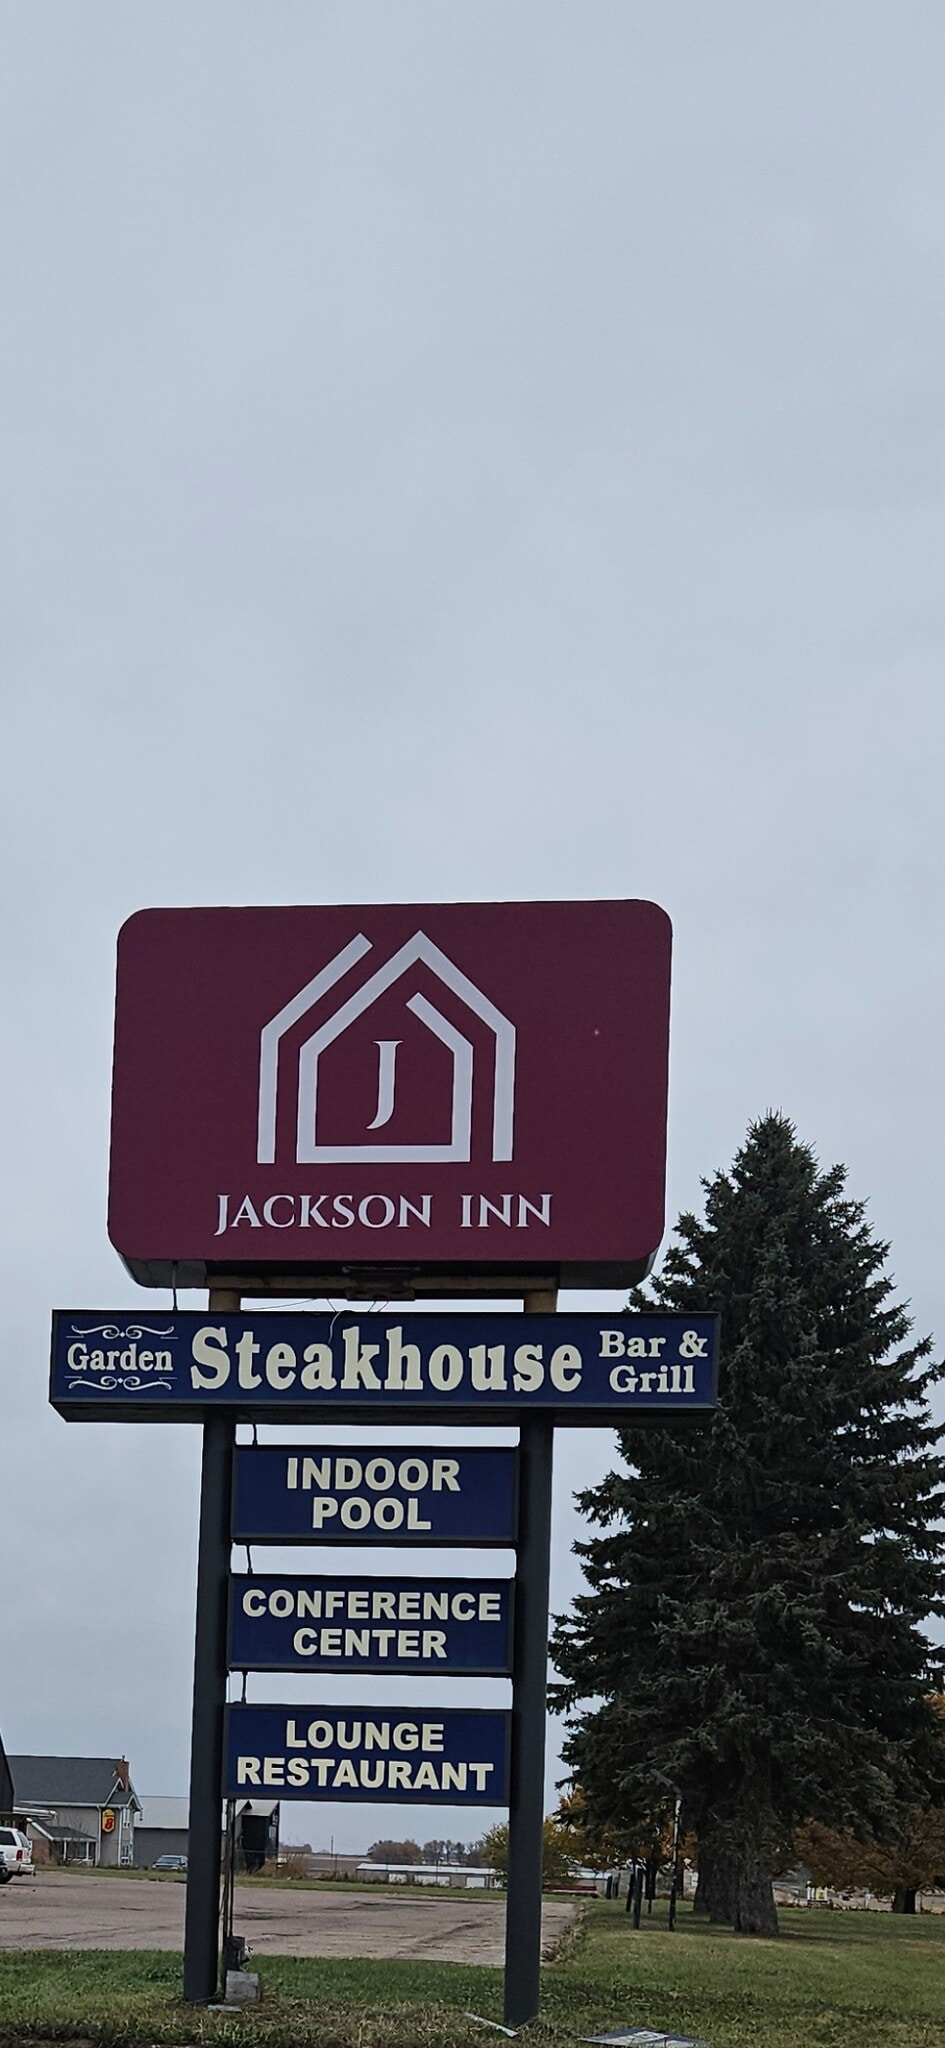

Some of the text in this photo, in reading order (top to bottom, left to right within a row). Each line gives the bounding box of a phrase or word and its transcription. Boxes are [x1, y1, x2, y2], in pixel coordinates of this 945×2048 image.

[366, 1040, 403, 1130] J
[214, 1194, 552, 1237] JACKSON INN
[67, 1342, 174, 1372] Garden
[191, 1326, 582, 1392] Steakhouse
[599, 1330, 708, 1358] Bar &
[609, 1364, 696, 1393] Grill
[286, 1457, 461, 1492] INDOOR
[312, 1497, 432, 1530] POOL
[242, 1589, 501, 1621] CONFERENCE
[293, 1628, 448, 1658] CENTER
[286, 1720, 444, 1751] LOUNGE
[237, 1756, 494, 1791] RESTAURANT
